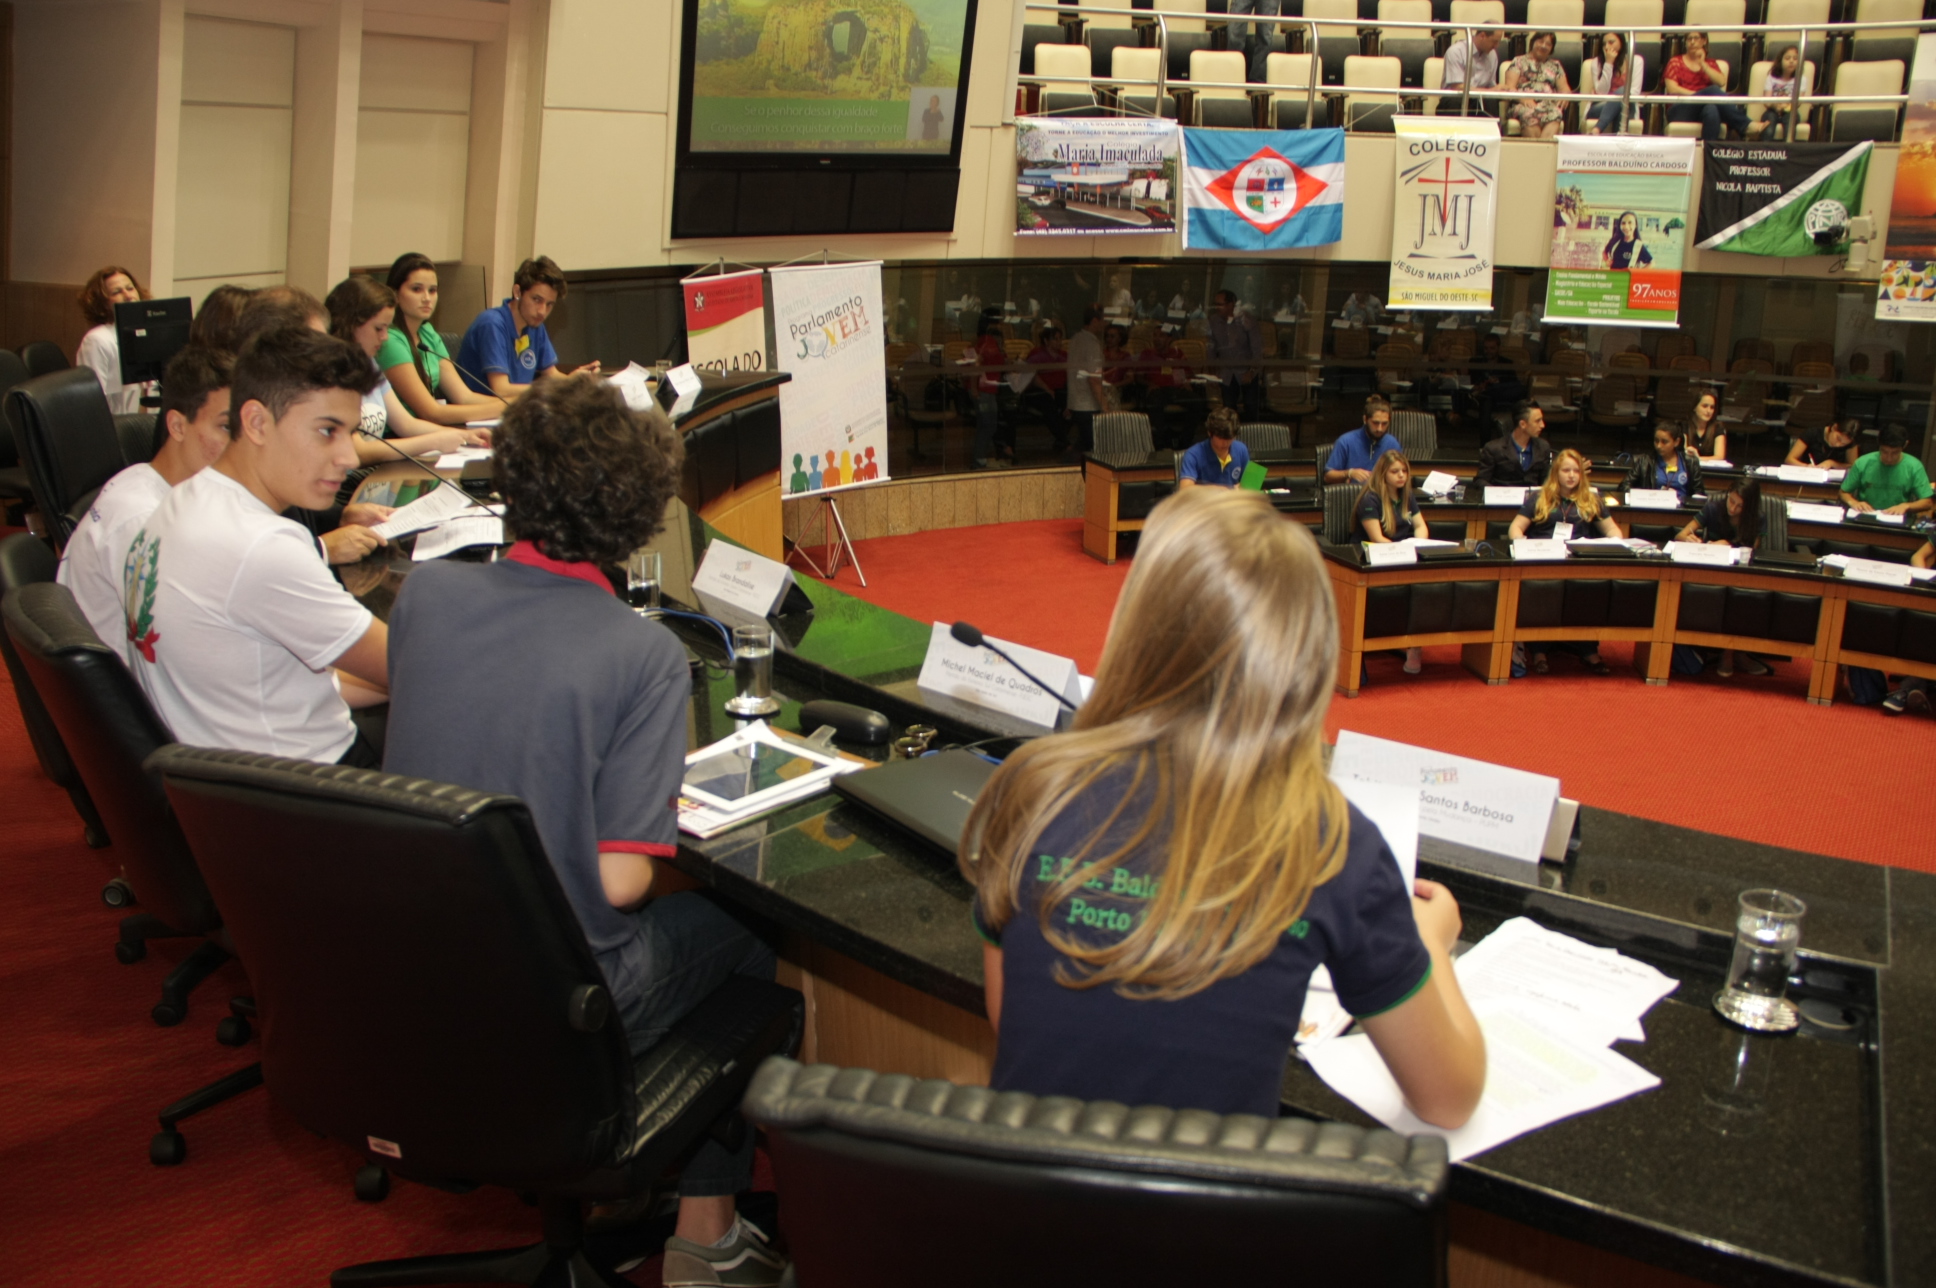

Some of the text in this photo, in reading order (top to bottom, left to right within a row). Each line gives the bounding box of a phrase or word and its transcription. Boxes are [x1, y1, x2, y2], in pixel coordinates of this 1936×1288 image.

[1058, 143, 1163, 162] Maria Imaculada
[1409, 136, 1487, 157] COLÉGIO
[1712, 147, 1787, 160] COLÉGIO ESTADUAL
[1562, 159, 1688, 169] PROFESSOR BALDUÍNO CARDOSO
[1729, 165, 1771, 177] PROFESSOR
[1716, 181, 1781, 194] NICOLA BAPTISTA
[1413, 193, 1475, 250] JMJ
[1394, 258, 1490, 281] JESUS MARIA JOSÉ
[1401, 291, 1479, 302] SÃO MIGUEL DO OESTE-SC
[790, 295, 863, 341] Parlamento
[743, 350, 762, 372] DO
[941, 658, 966, 673] Michel
[967, 665, 995, 682] Maciel
[995, 675, 1006, 685] de
[1008, 678, 1043, 697] Quadros
[1420, 790, 1458, 810] Santos
[1462, 800, 1514, 823] Barbosa
[1066, 898, 1132, 932] Porto
